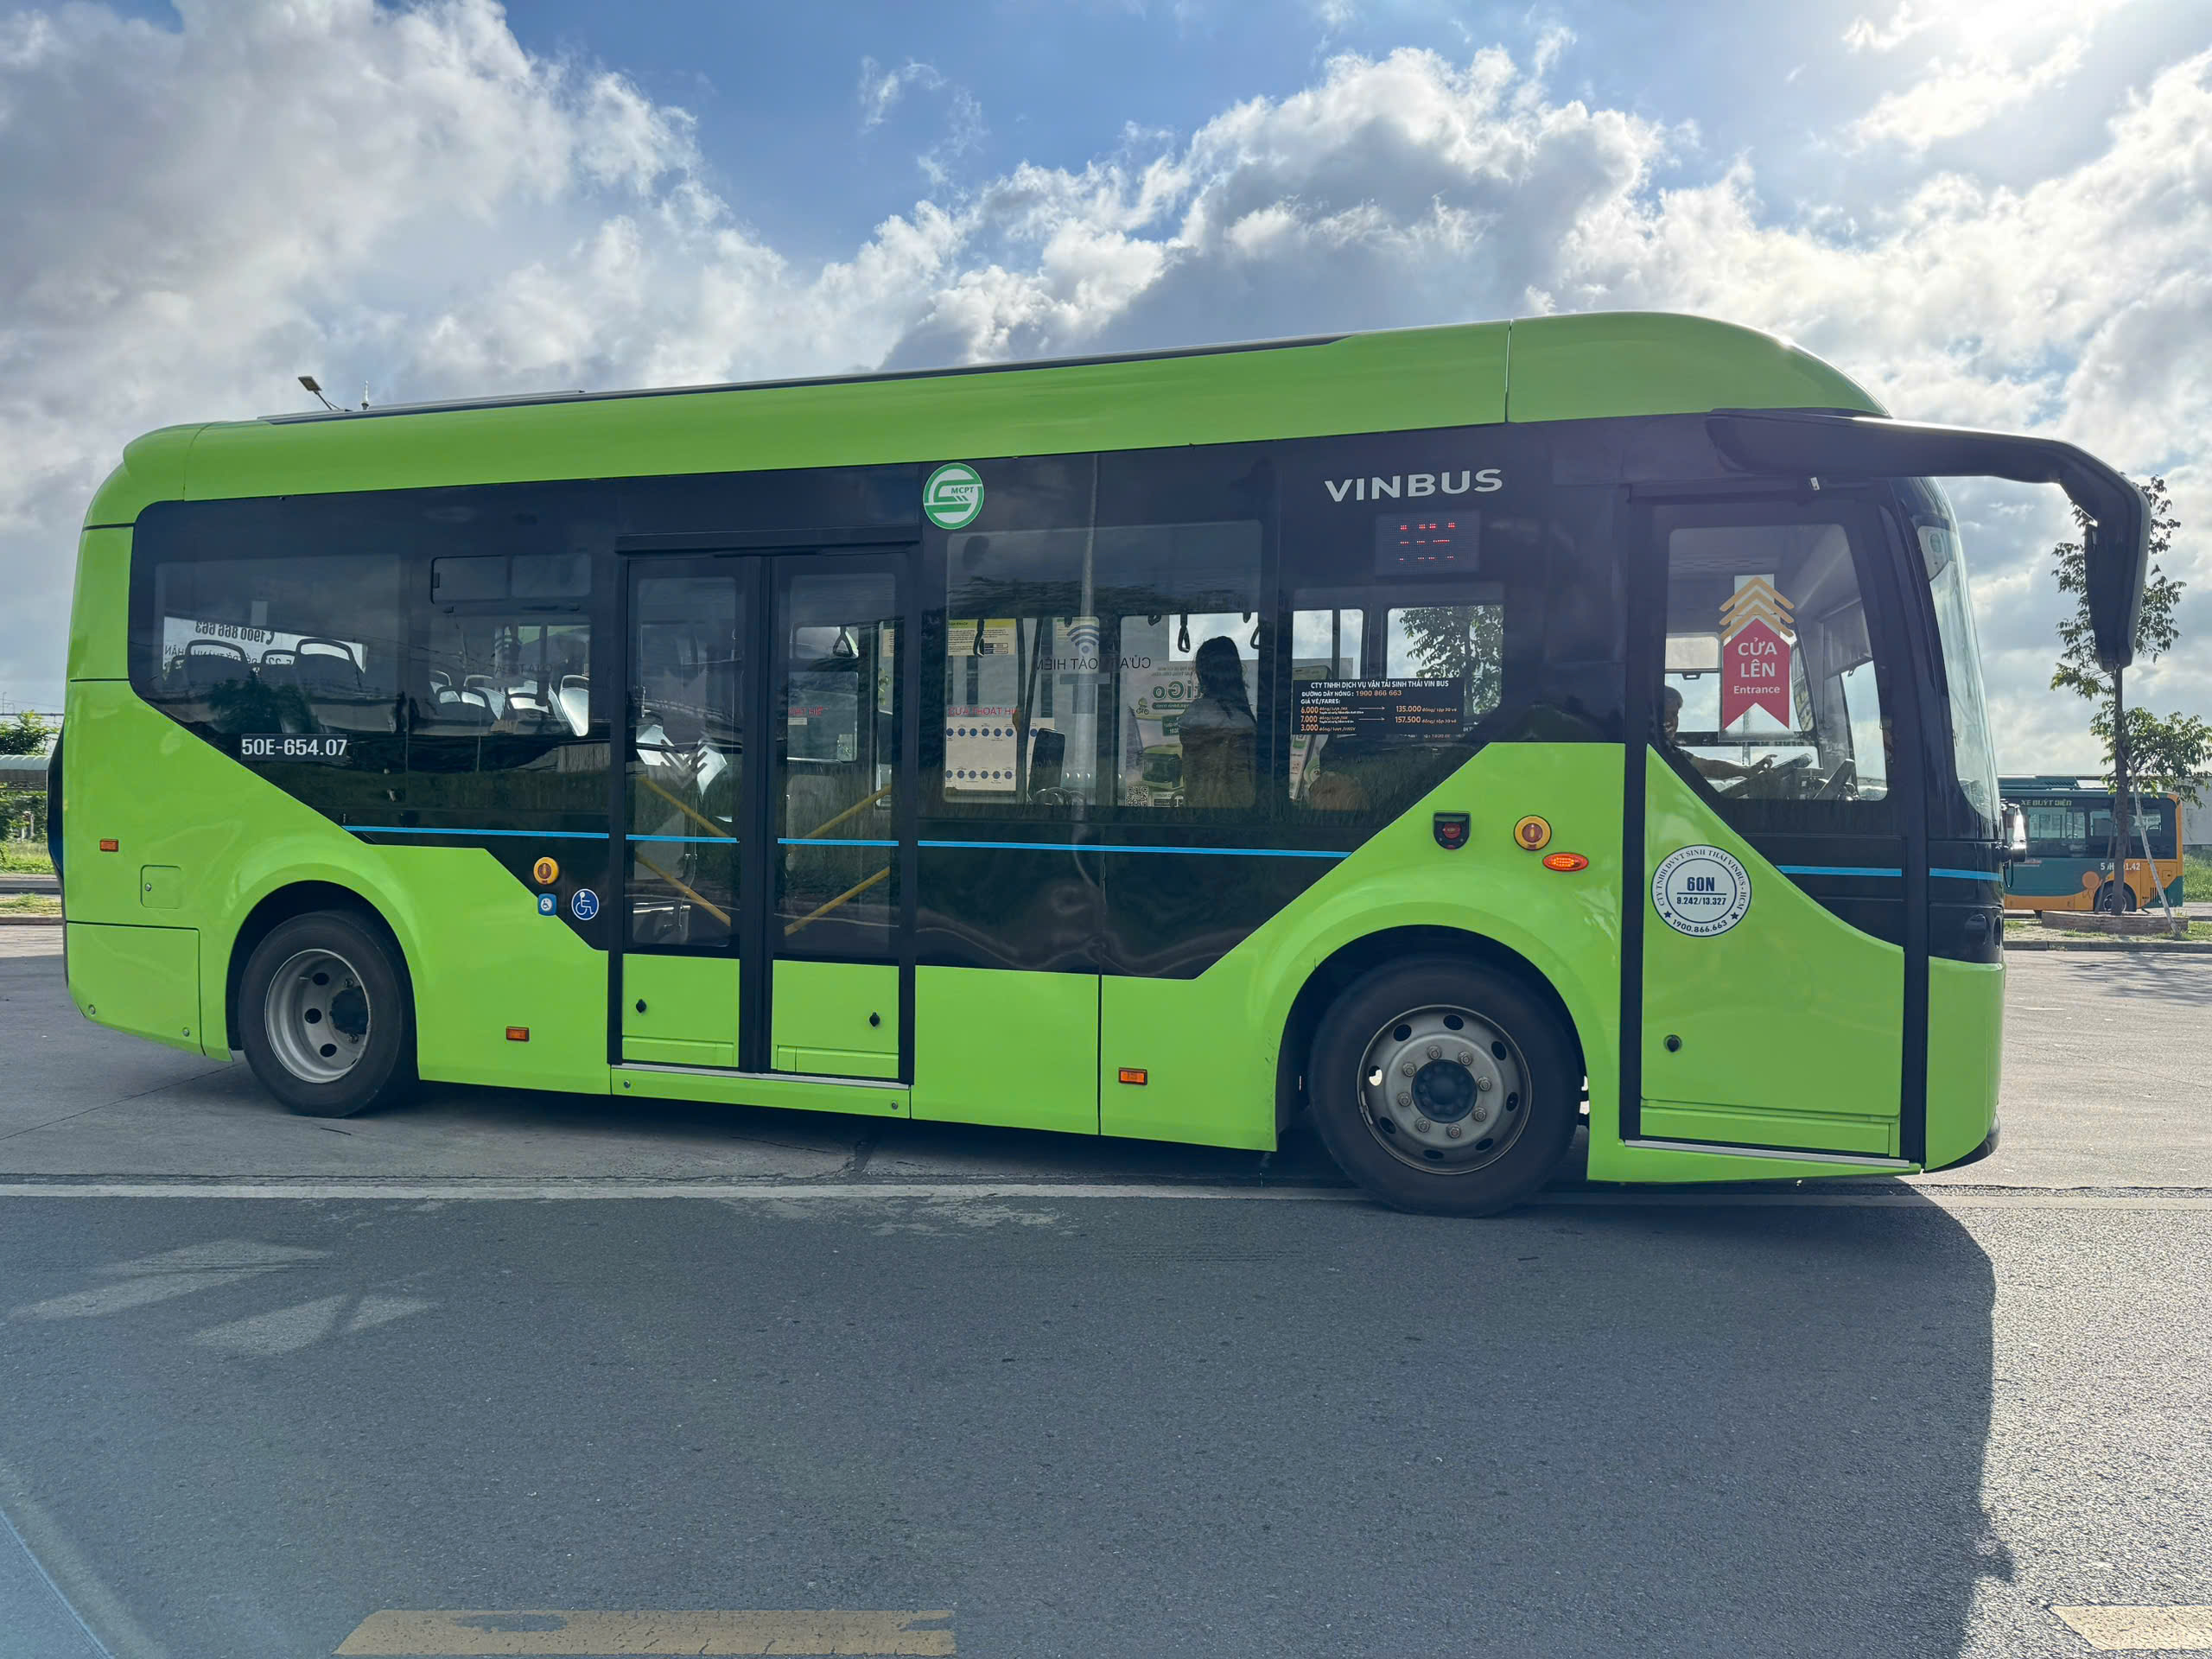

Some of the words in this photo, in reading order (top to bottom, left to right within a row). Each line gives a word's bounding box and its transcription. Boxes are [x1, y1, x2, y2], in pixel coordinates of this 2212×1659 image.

[950, 486, 975, 494] MCPT
[1324, 468, 1503, 503] VINBUS
[1737, 637, 1777, 656] CỬA
[1740, 658, 1776, 677] LÊN
[1341, 681, 1357, 690] DỊCH
[1357, 681, 1366, 690] VỤ
[1367, 679, 1381, 690] VẬN
[1381, 679, 1390, 688] TẢI
[1408, 679, 1422, 688] THÁI
[1733, 685, 1781, 695] Entrance
[241, 738, 347, 756] 50E-654.07
[1666, 853, 1685, 869] DVVT
[1686, 849, 1706, 857] SINH
[1707, 849, 1728, 862] THÁI
[1656, 868, 1669, 889] TNHH
[1727, 859, 1746, 887] VINBUS
[1687, 876, 1715, 892] 60N
[1656, 891, 1665, 906] CTY
[1676, 896, 1726, 906] 8.242/13.327
[1736, 892, 1747, 910] HCM
[1672, 918, 1728, 933] 1900.866.663
